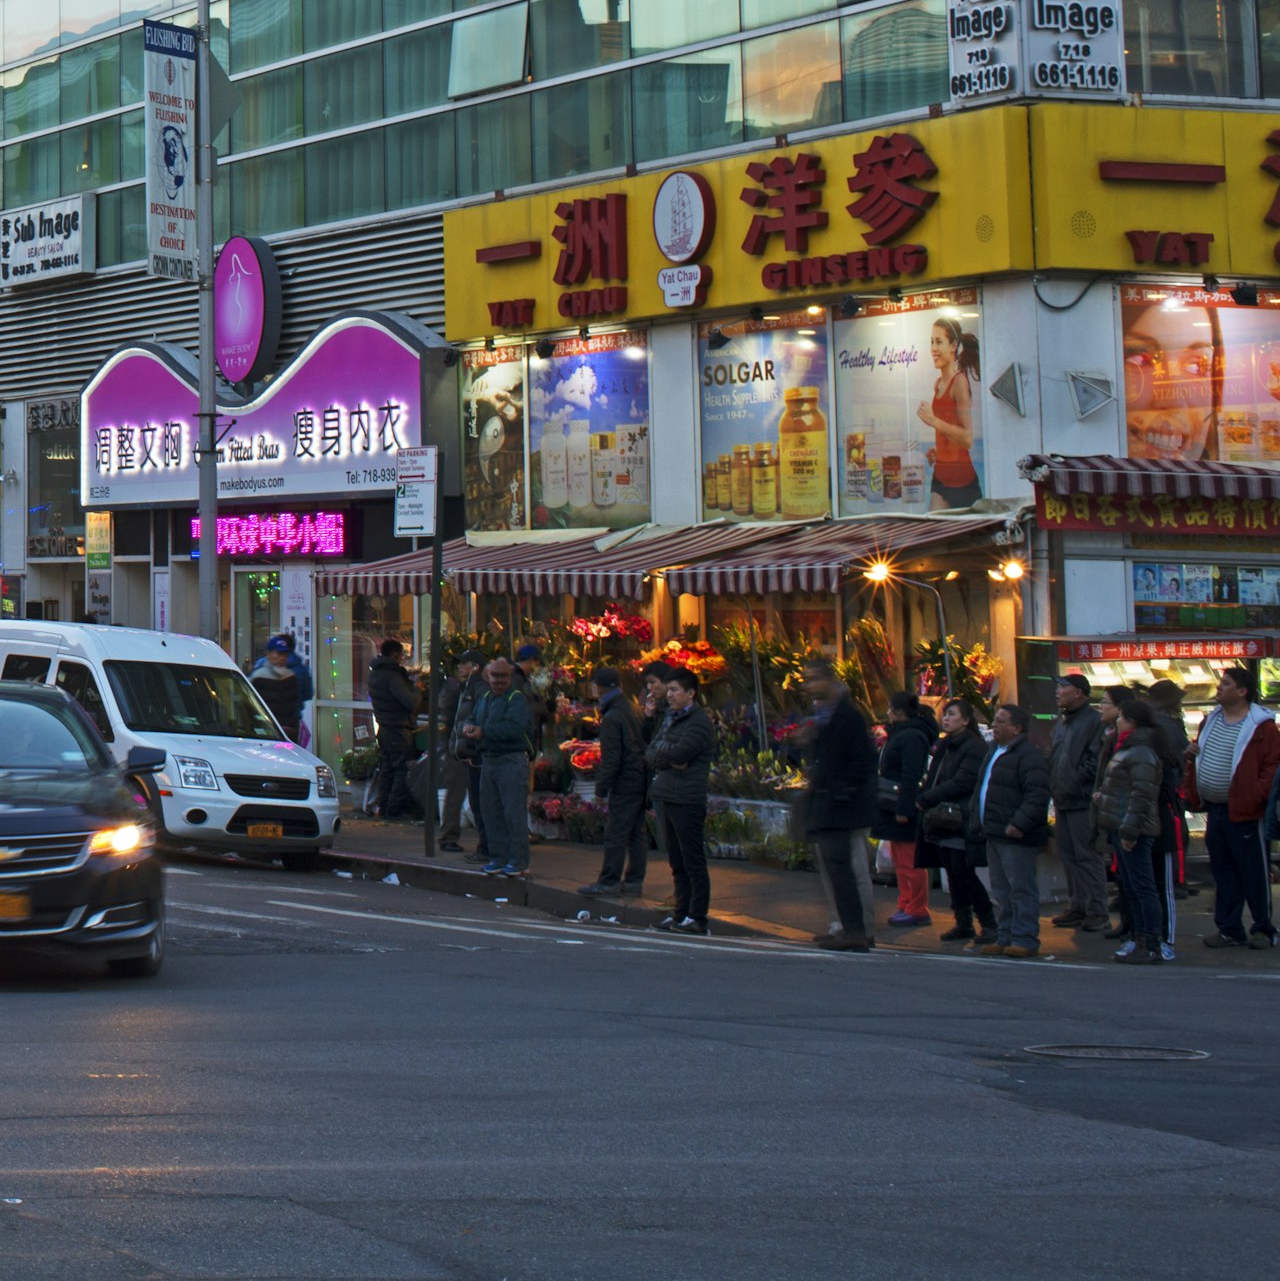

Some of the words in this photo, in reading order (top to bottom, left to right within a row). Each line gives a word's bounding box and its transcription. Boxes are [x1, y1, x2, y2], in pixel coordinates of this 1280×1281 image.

[949, 4, 1007, 43] Image
[145, 26, 181, 50] FLUSHING
[181, 33, 195, 53] BID
[966, 48, 988, 66] 718
[1059, 43, 1092, 61] 718
[950, 65, 1011, 99] 661-1116
[1034, 61, 1120, 91] 661-1116
[148, 90, 183, 109] WELCOME
[150, 202, 196, 221] DESTINATION
[13, 212, 36, 243] Sub
[39, 209, 80, 239] Image
[167, 221, 177, 234] OF
[159, 236, 186, 252] CHOICE
[476, 192, 628, 287] 一洲
[1125, 229, 1215, 264] YAT
[27, 245, 47, 259] BEAUTY
[47, 241, 65, 255] SALON
[486, 297, 536, 328] YAT
[556, 285, 628, 319] CHAU
[761, 242, 930, 291] GINSENG
[661, 269, 677, 284] Yat
[678, 267, 699, 283] Chau
[669, 286, 692, 302] 一洲
[221, 345, 236, 356] MAKE
[237, 343, 252, 354] BODY
[839, 347, 876, 373] Healthy
[877, 344, 919, 373] Lifestyle
[703, 359, 776, 387] SOLGAR
[725, 409, 748, 420] 1947
[227, 437, 253, 462] Fitted
[257, 434, 280, 460] Bras
[398, 450, 406, 458] NO
[406, 449, 428, 457] PARKING
[398, 484, 405, 498] 2
